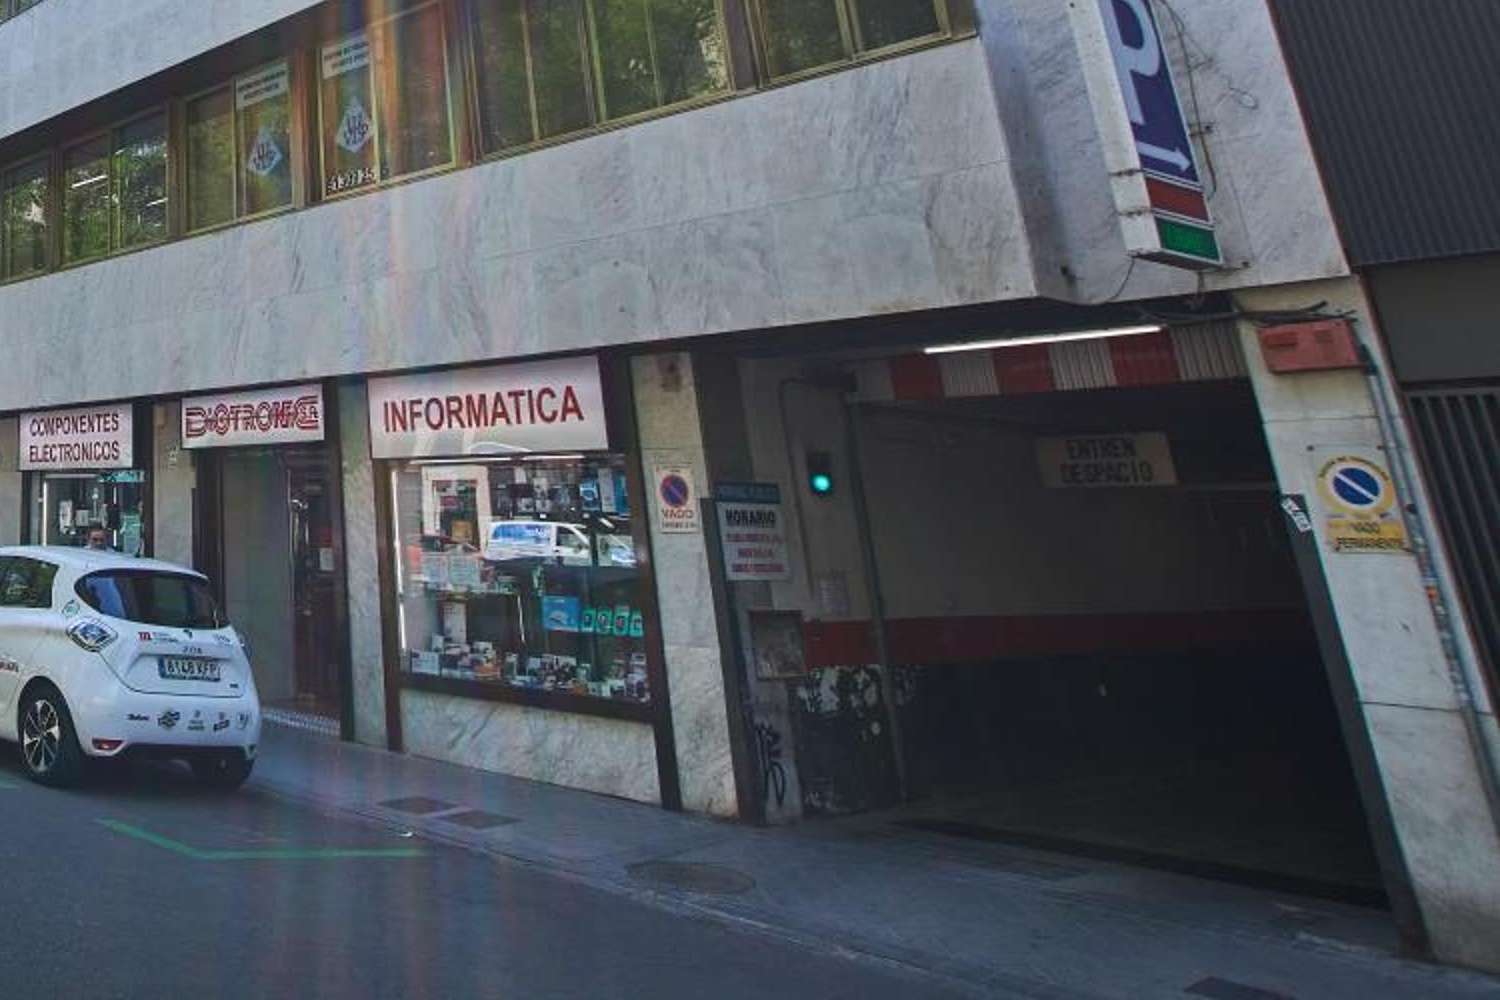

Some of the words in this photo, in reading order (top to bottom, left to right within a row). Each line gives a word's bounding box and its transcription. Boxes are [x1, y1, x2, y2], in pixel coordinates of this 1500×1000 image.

[383, 385, 584, 433] INFORMATICA
[30, 413, 120, 436] COMPONENTES
[29, 441, 120, 463] ELECTRONICOS
[1066, 439, 1135, 458] ENTREN
[1061, 460, 1154, 484] DESPACIO
[661, 508, 693, 519] VADO
[725, 509, 775, 526] HORARIO
